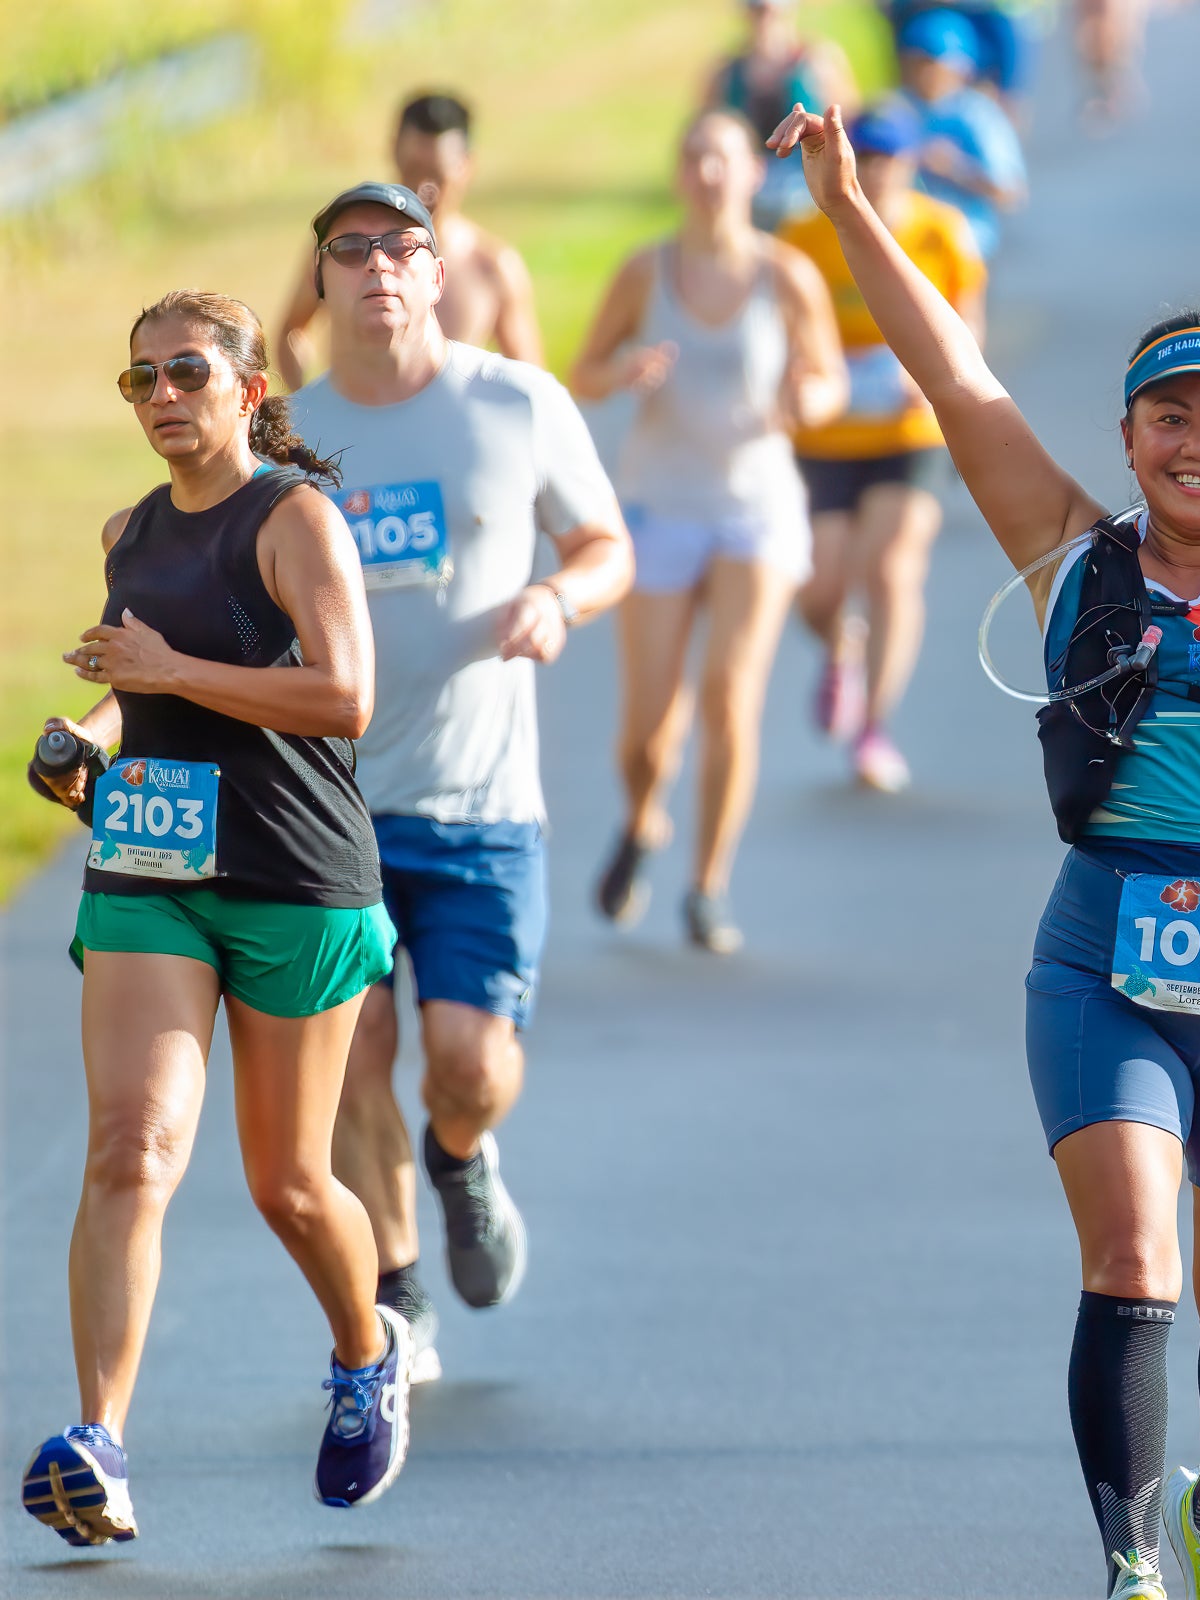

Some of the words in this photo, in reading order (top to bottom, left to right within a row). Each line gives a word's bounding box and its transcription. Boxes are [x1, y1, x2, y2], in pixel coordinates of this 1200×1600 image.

[1157, 344, 1173, 361] THE
[349, 511, 440, 559] 105
[104, 790, 204, 839] 2103
